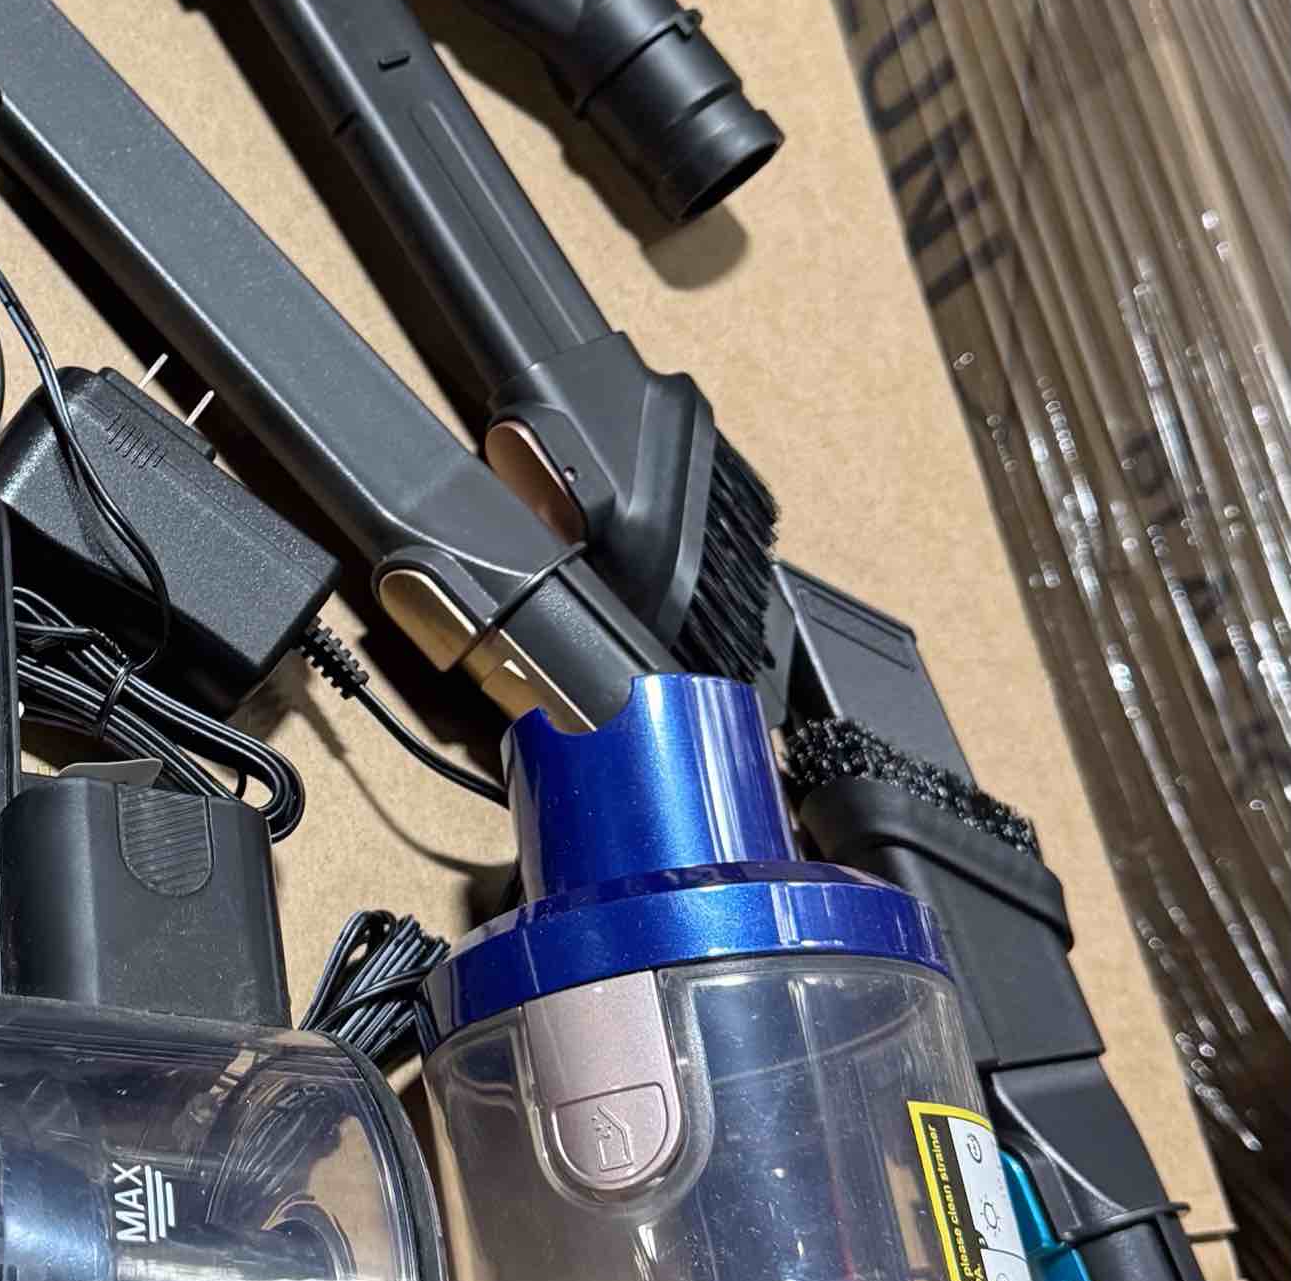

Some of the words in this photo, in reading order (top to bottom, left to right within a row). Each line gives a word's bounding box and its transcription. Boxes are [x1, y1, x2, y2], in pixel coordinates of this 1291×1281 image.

[927, 1123, 949, 1182] strainer
[112, 1162, 146, 1242] MAX
[943, 1184, 959, 1226] clean
[954, 1227, 974, 1277] please
